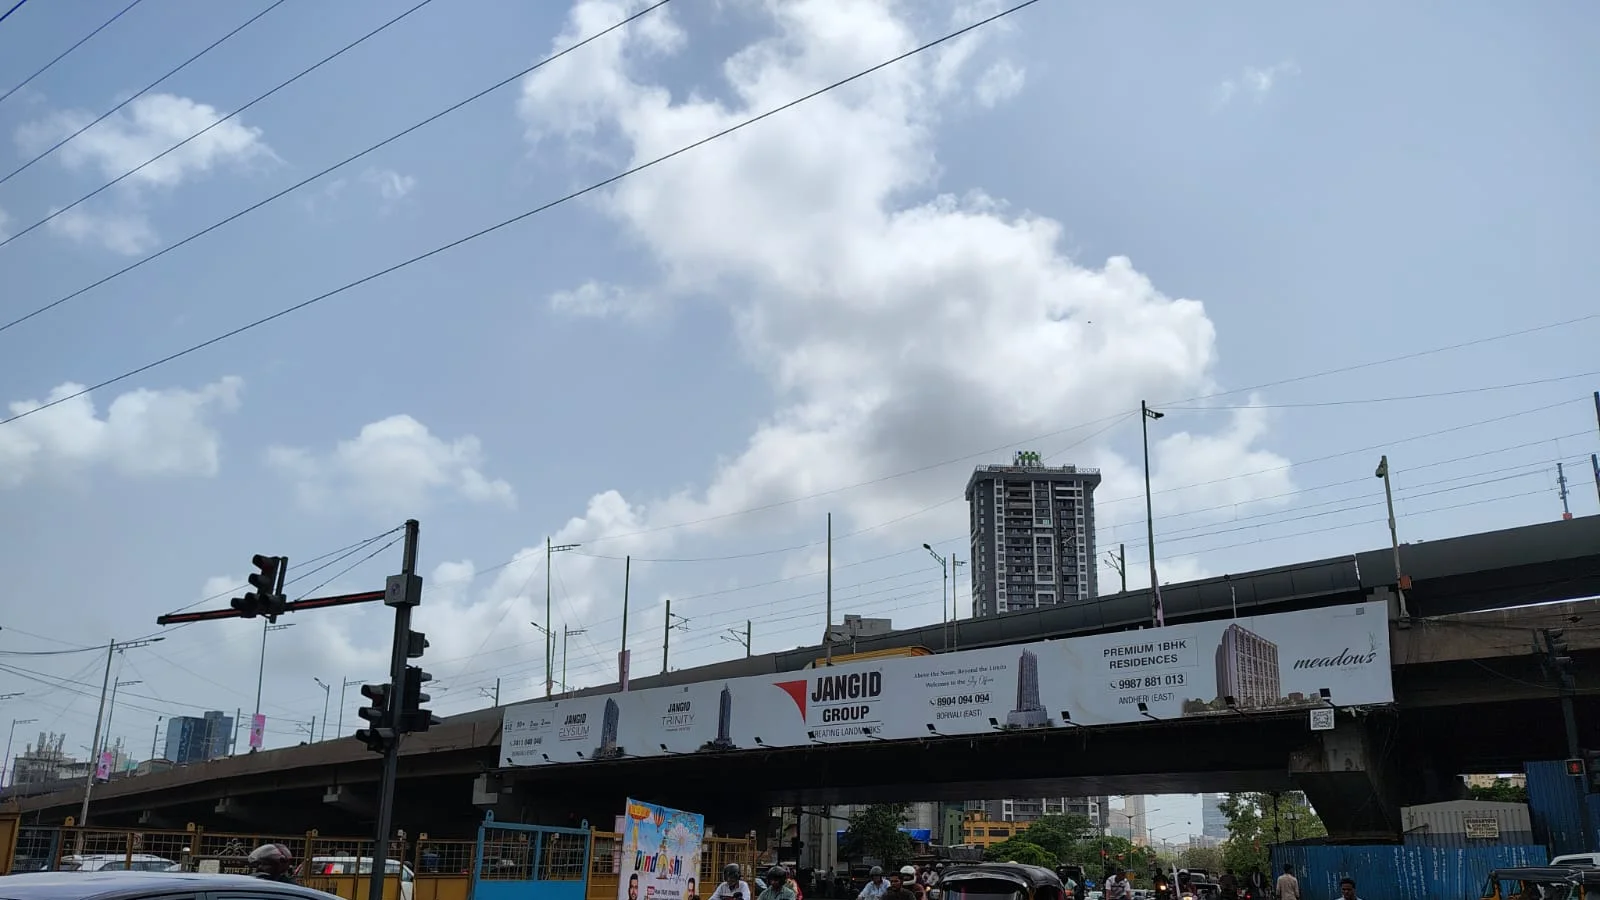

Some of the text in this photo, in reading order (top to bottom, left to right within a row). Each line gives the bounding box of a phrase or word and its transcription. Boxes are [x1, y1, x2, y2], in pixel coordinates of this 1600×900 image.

[1103, 640, 1187, 658] PREMIUM 1BHK
[1110, 653, 1178, 669] RESIDENCES
[1293, 647, 1377, 670] meadows
[811, 671, 882, 702] JANGID
[1119, 674, 1184, 689] 9987 881 013
[937, 693, 990, 706] 8904 094 094
[1119, 692, 1175, 704] ANDHERI (EAST)
[668, 701, 691, 712] JANGID
[564, 713, 587, 725] JANGID
[823, 705, 870, 722] GROUP
[937, 708, 983, 719] BORIVALI (EAST)
[661, 714, 695, 726] TRINITY
[559, 726, 590, 737] ELYSIUM
[814, 728, 840, 738] REATING
